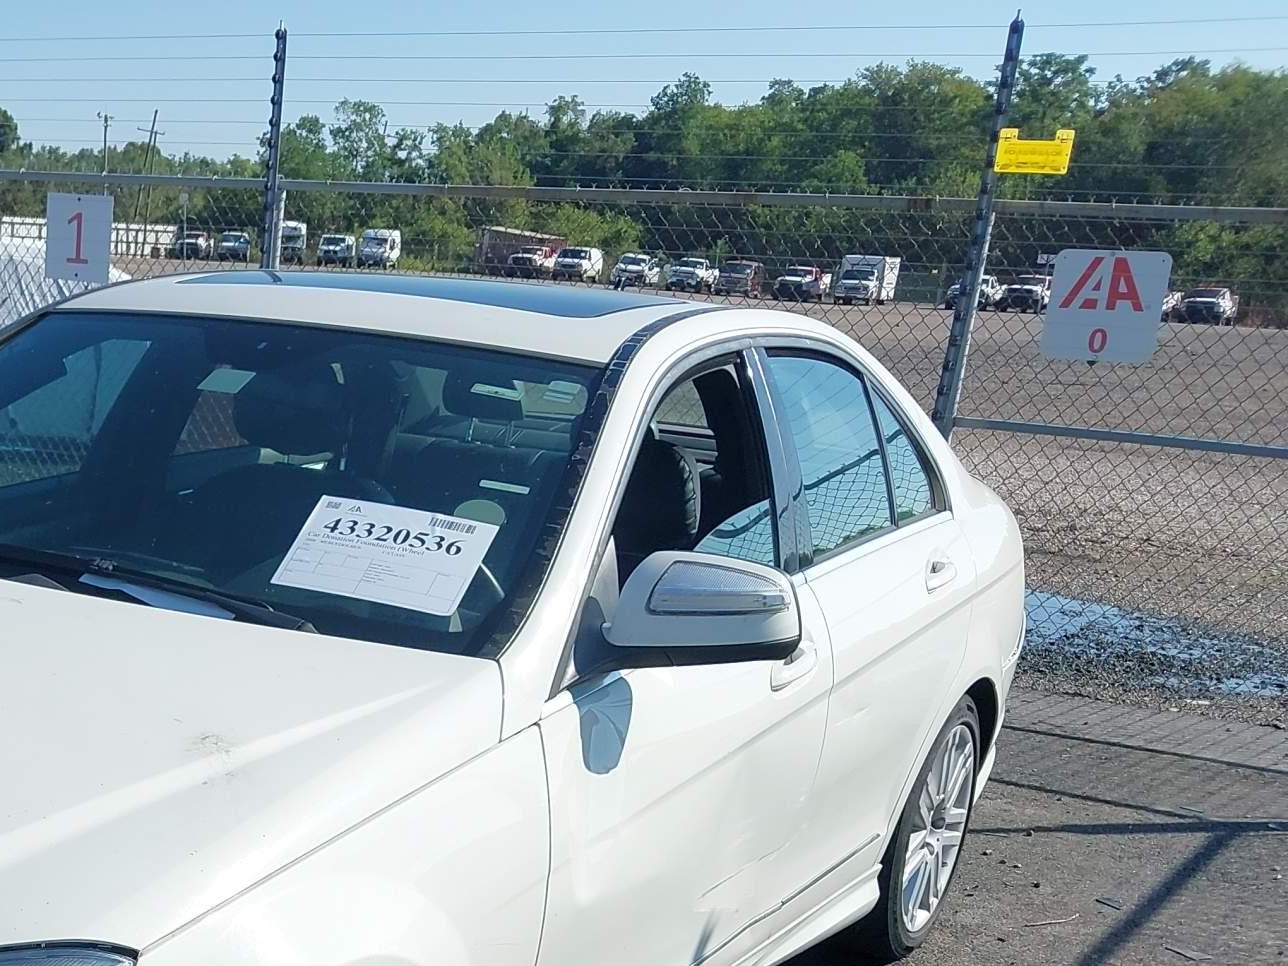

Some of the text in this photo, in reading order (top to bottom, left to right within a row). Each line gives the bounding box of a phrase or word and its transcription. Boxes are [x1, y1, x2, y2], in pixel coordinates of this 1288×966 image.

[66, 212, 88, 264] 1
[322, 532, 354, 543] Donation
[355, 539, 396, 551] Foundation
[323, 517, 468, 556] 43320536
